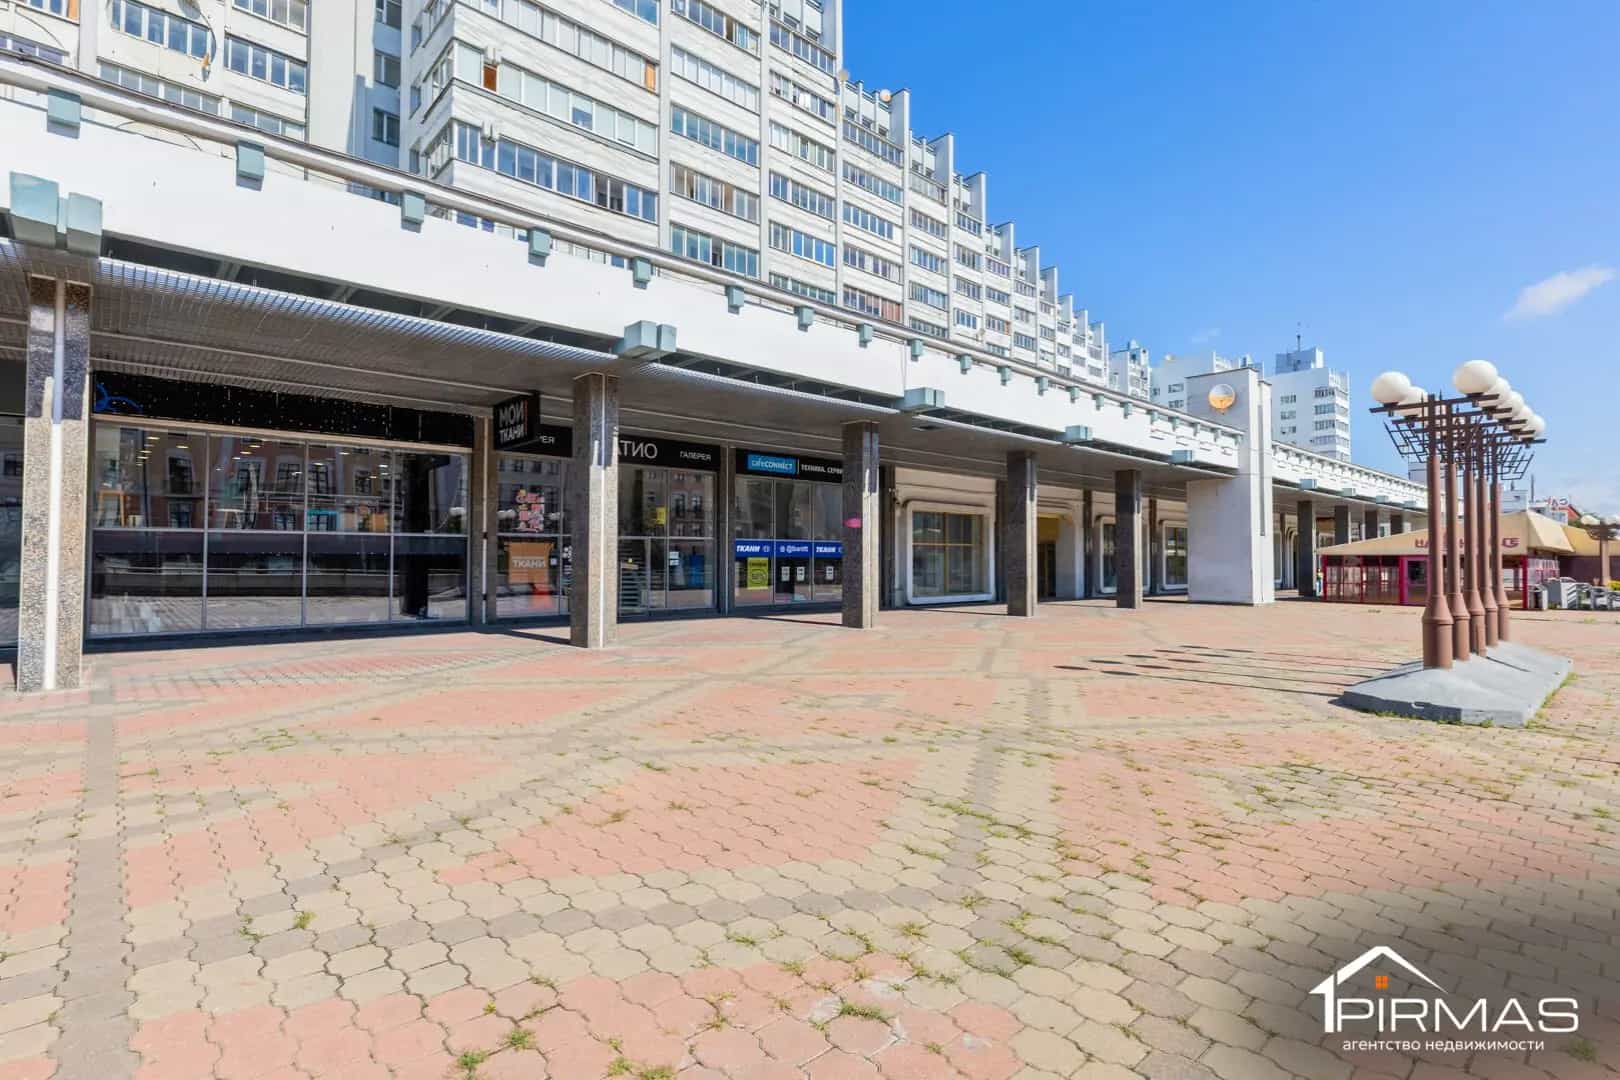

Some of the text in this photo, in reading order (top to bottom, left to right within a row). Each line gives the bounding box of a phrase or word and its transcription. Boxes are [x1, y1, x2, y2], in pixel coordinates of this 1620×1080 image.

[500, 424, 524, 443] ТКАНИ
[618, 440, 712, 462] ТИО ГАЛЕРЕЯ
[512, 559, 545, 569] ТКАНИ
